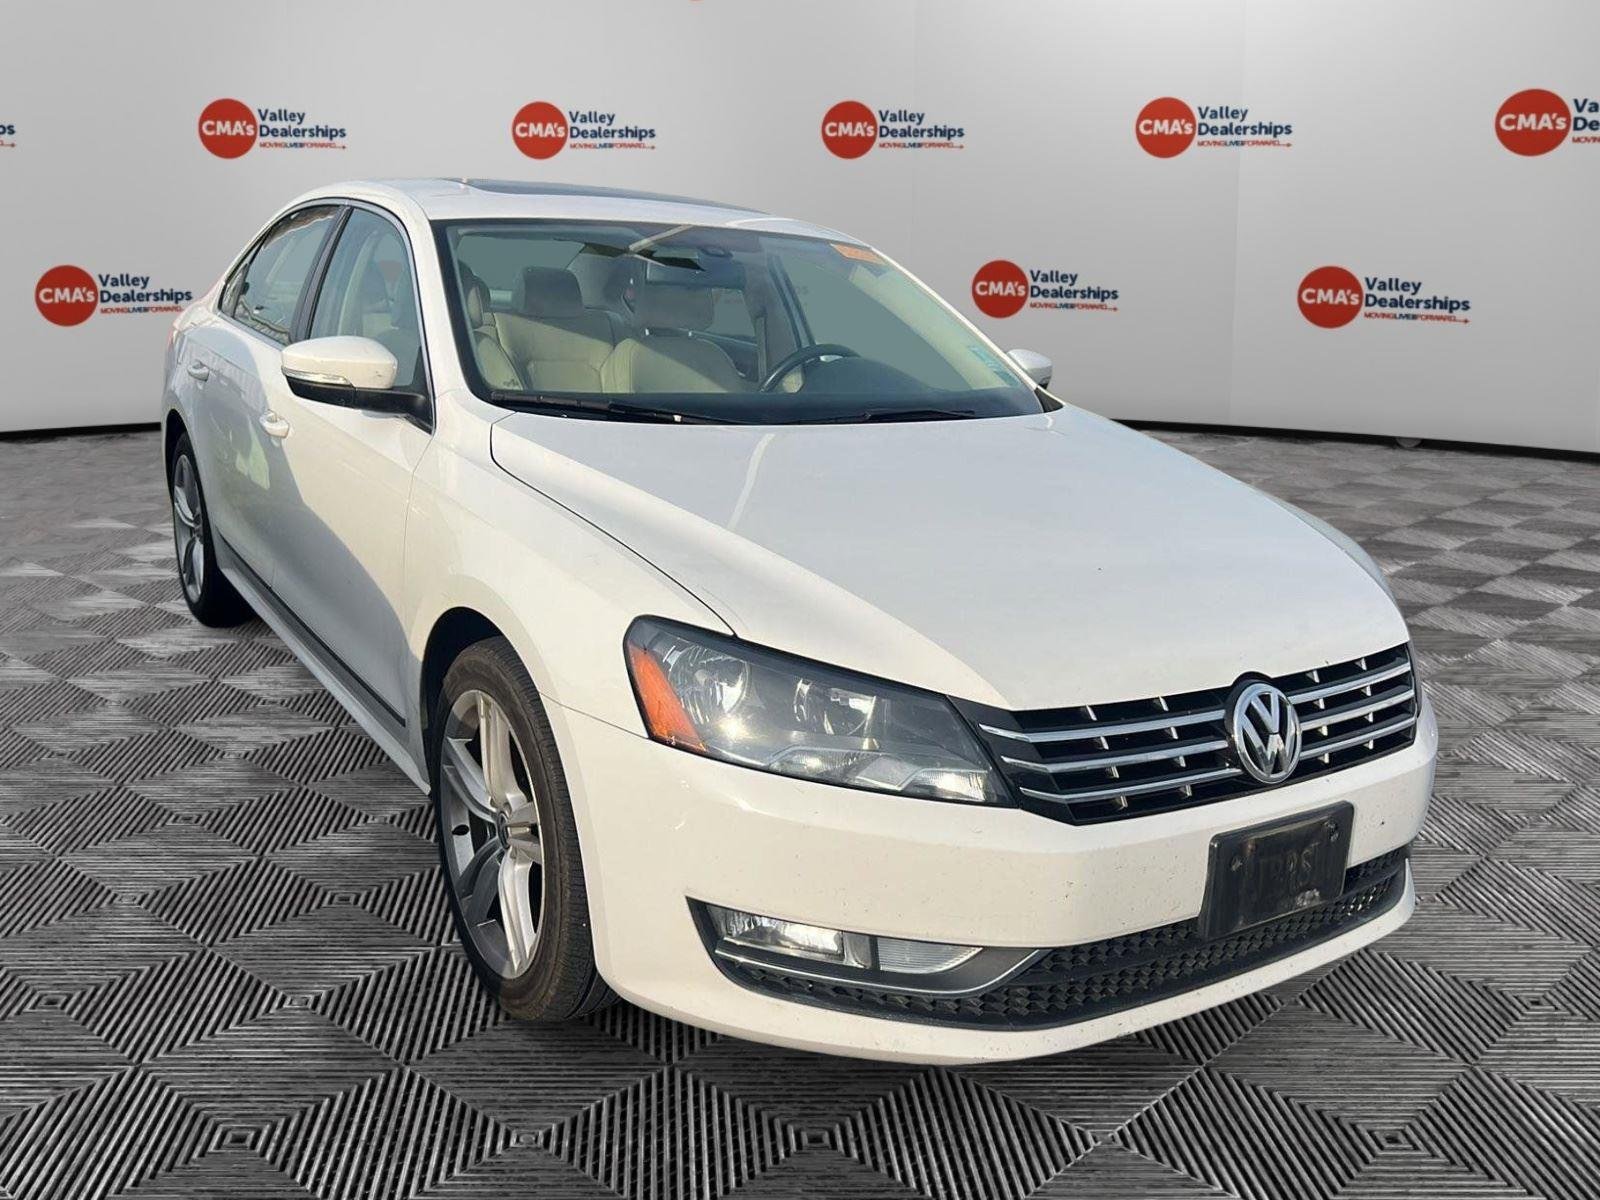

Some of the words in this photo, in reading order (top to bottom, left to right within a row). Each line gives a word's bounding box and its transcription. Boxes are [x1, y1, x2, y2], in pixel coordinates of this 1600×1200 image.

[258, 108, 306, 125] Valley
[569, 111, 616, 126] Valley
[878, 110, 925, 125] Valley
[1197, 106, 1248, 122] Valley
[1499, 112, 1567, 131] CMA's
[201, 120, 255, 137] CMA's
[259, 124, 346, 141] Dealerships
[515, 122, 566, 138] CMA's
[569, 126, 656, 141] Dealerships
[825, 121, 875, 137] CMA's
[879, 125, 965, 140] Dealerships
[1138, 118, 1194, 135] CMA's
[1197, 122, 1293, 138] Dealerships
[98, 273, 150, 289] Valley
[1030, 270, 1078, 286] Valley
[1364, 277, 1422, 295] Valley
[38, 287, 95, 304] CMA's
[99, 288, 193, 304] Dealerships
[975, 281, 1026, 297] CMA's
[1030, 285, 1119, 302] Dealerships
[1301, 288, 1360, 306] CMA's
[1364, 293, 1471, 313] Dealerships
